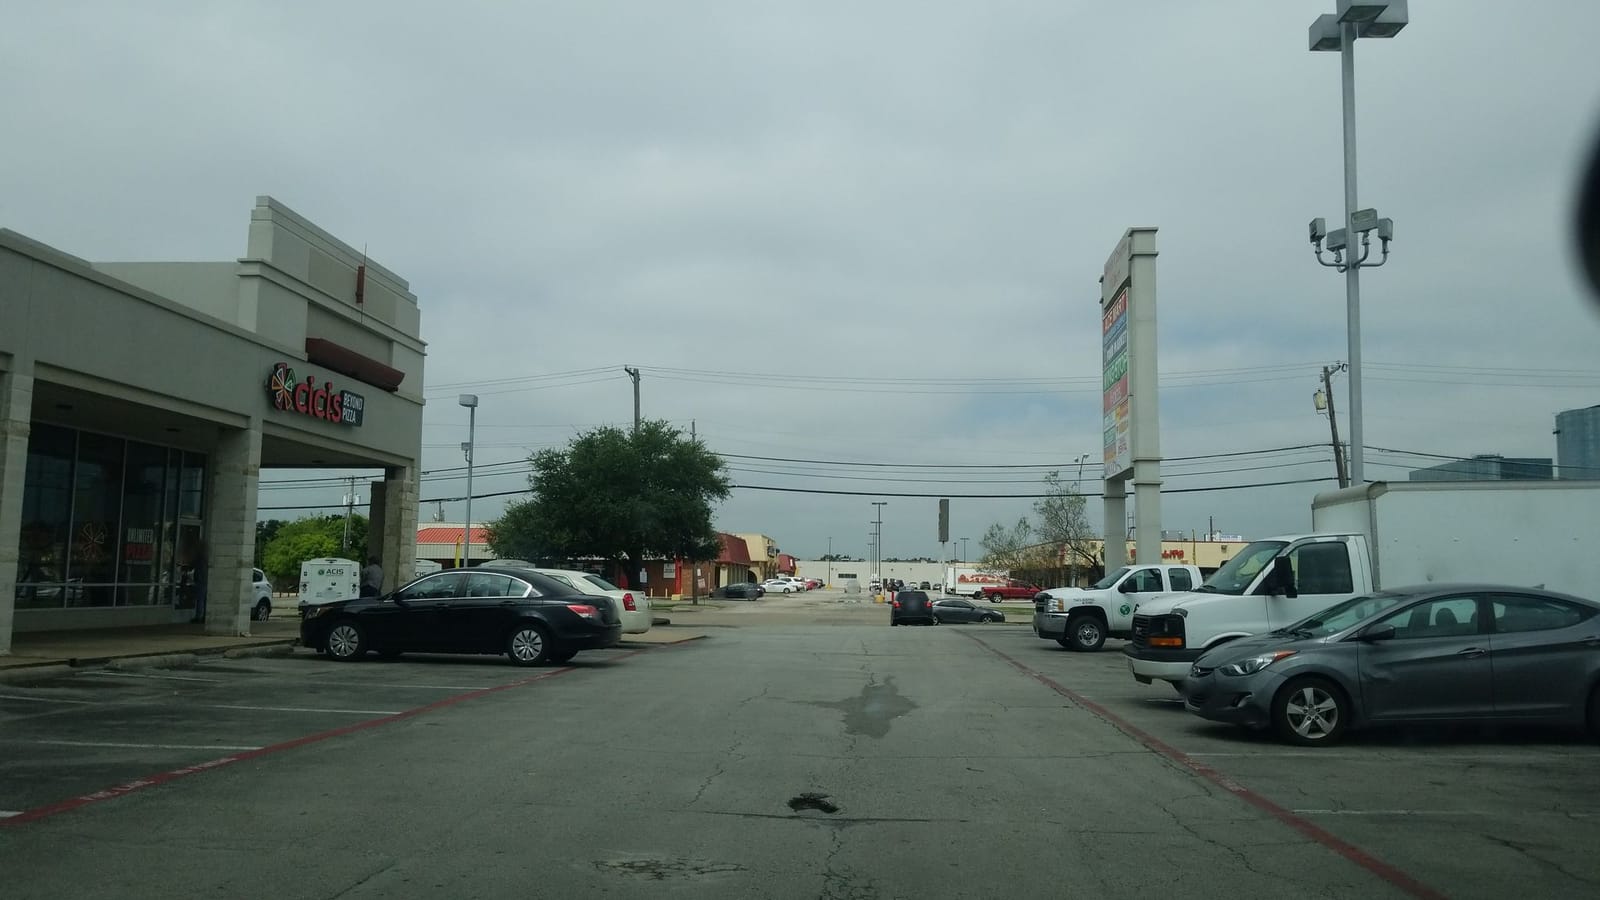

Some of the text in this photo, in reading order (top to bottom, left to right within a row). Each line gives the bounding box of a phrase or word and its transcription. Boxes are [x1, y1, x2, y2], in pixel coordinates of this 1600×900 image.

[295, 376, 342, 423] cicis
[343, 393, 363, 410] BEYOND
[342, 408, 356, 424] PIZZA
[127, 528, 153, 544] UNLIMITED
